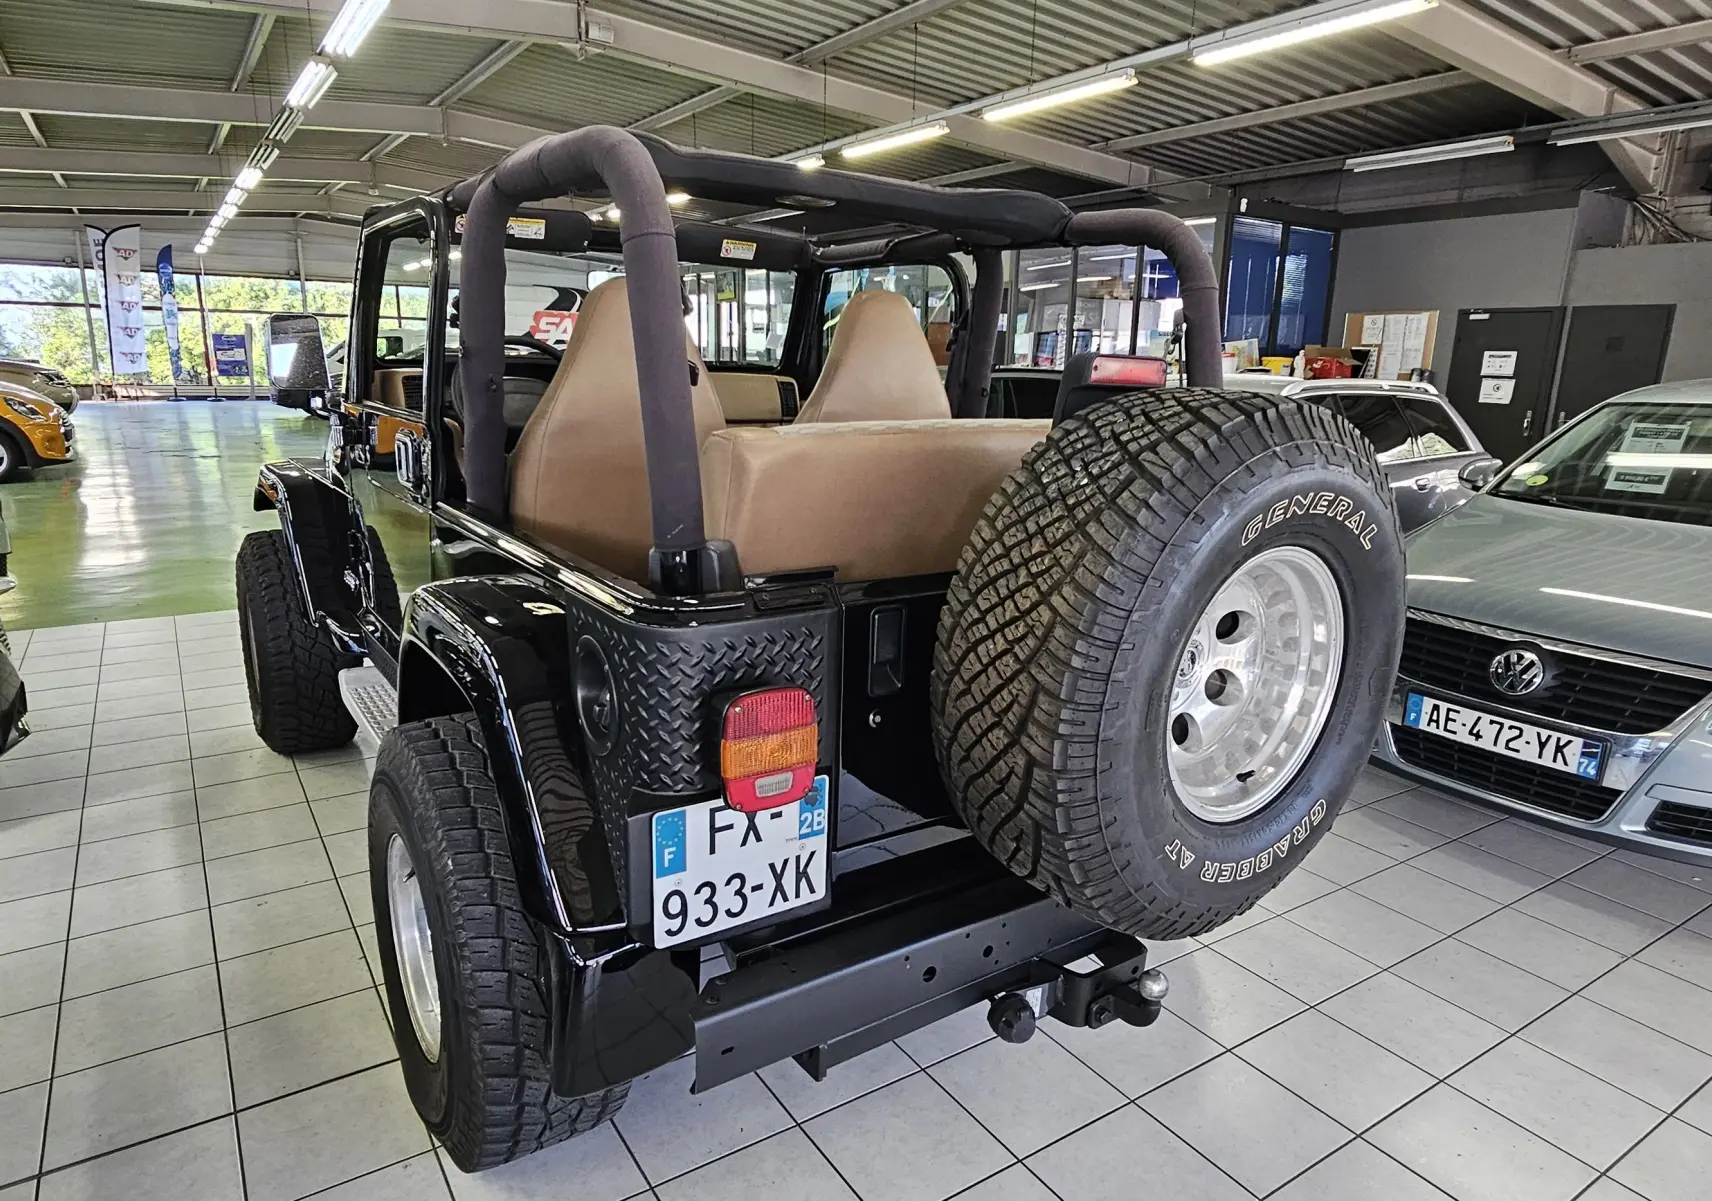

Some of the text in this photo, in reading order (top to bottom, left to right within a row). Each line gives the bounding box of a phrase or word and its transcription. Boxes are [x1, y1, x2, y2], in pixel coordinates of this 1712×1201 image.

[1241, 492, 1378, 550] GENERAL
[1410, 713, 1417, 721] F
[1422, 703, 1575, 767] AE-472-YK
[1579, 758, 1597, 775] 74
[800, 808, 826, 835] 2B
[1164, 799, 1327, 883] GRABBER AT
[664, 846, 677, 868] F
[662, 850, 817, 937] 933-XK
